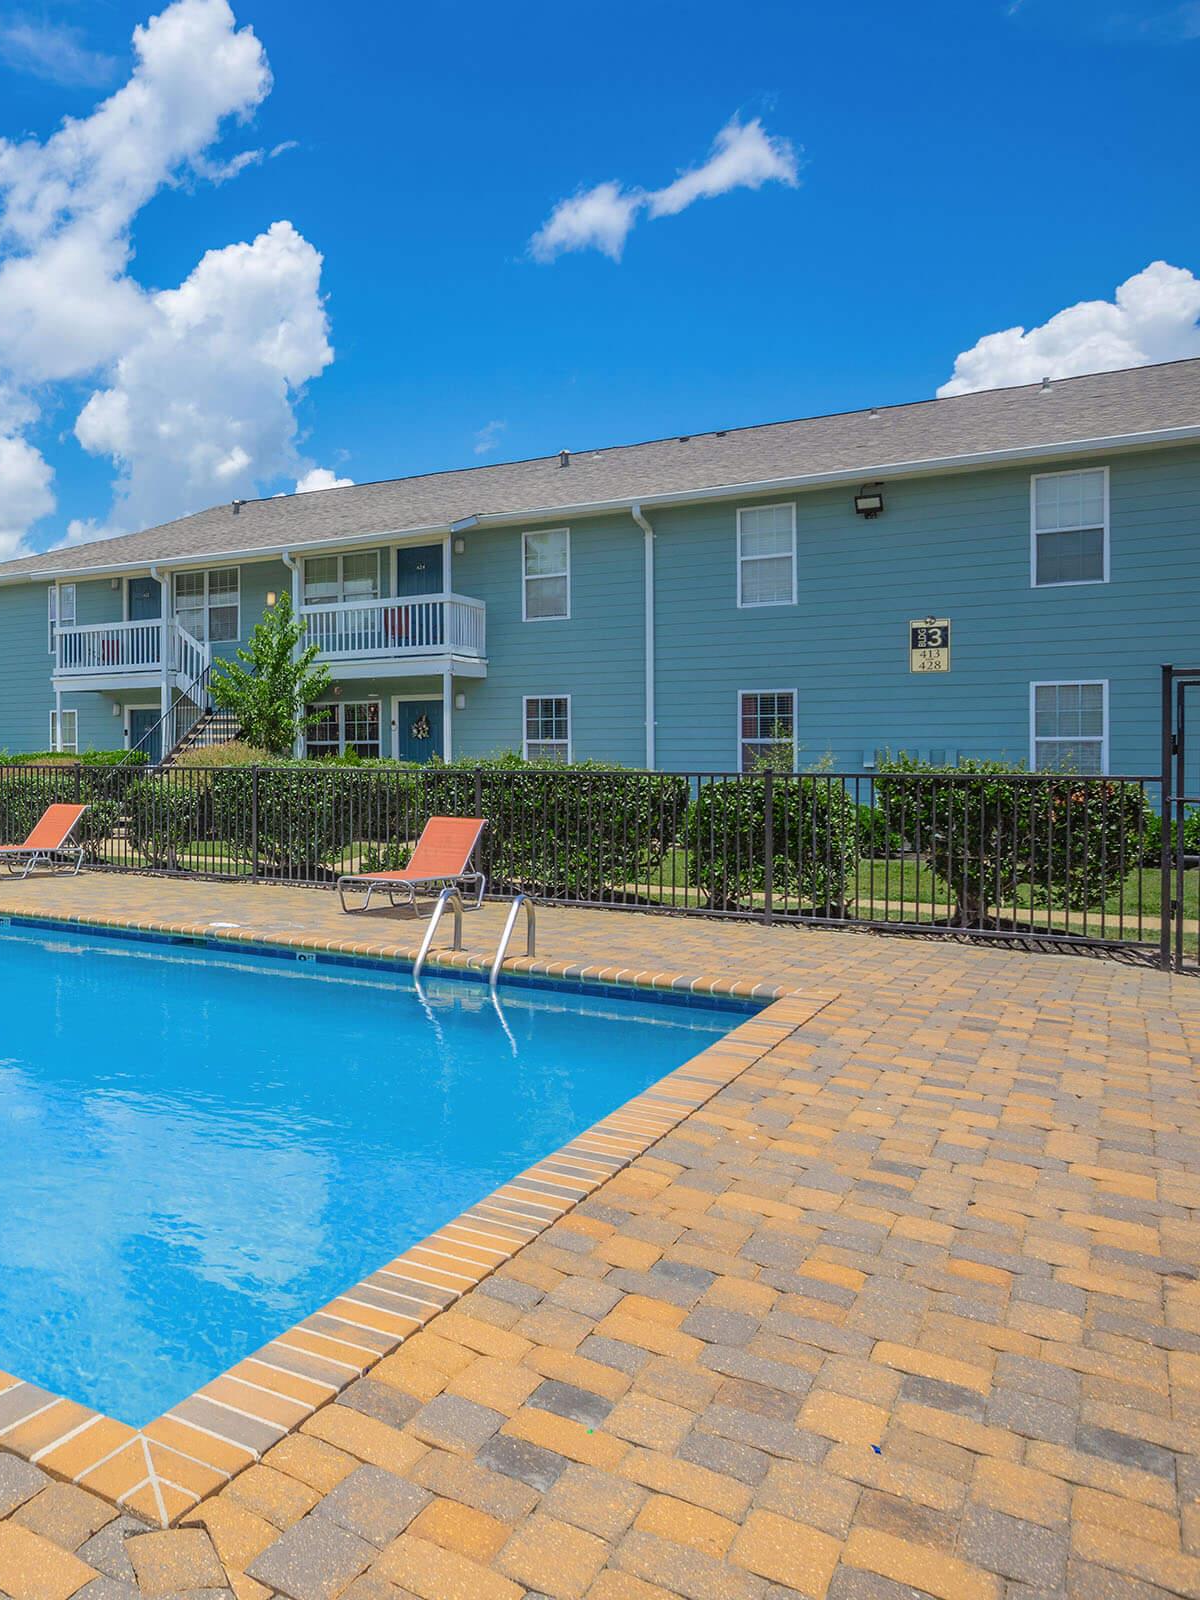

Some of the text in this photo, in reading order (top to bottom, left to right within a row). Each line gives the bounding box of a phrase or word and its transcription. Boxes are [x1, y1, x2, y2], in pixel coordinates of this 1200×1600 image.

[918, 628, 926, 647] BLDG
[927, 628, 942, 647] 3
[920, 650, 940, 658] 413
[918, 660, 941, 670] 428
